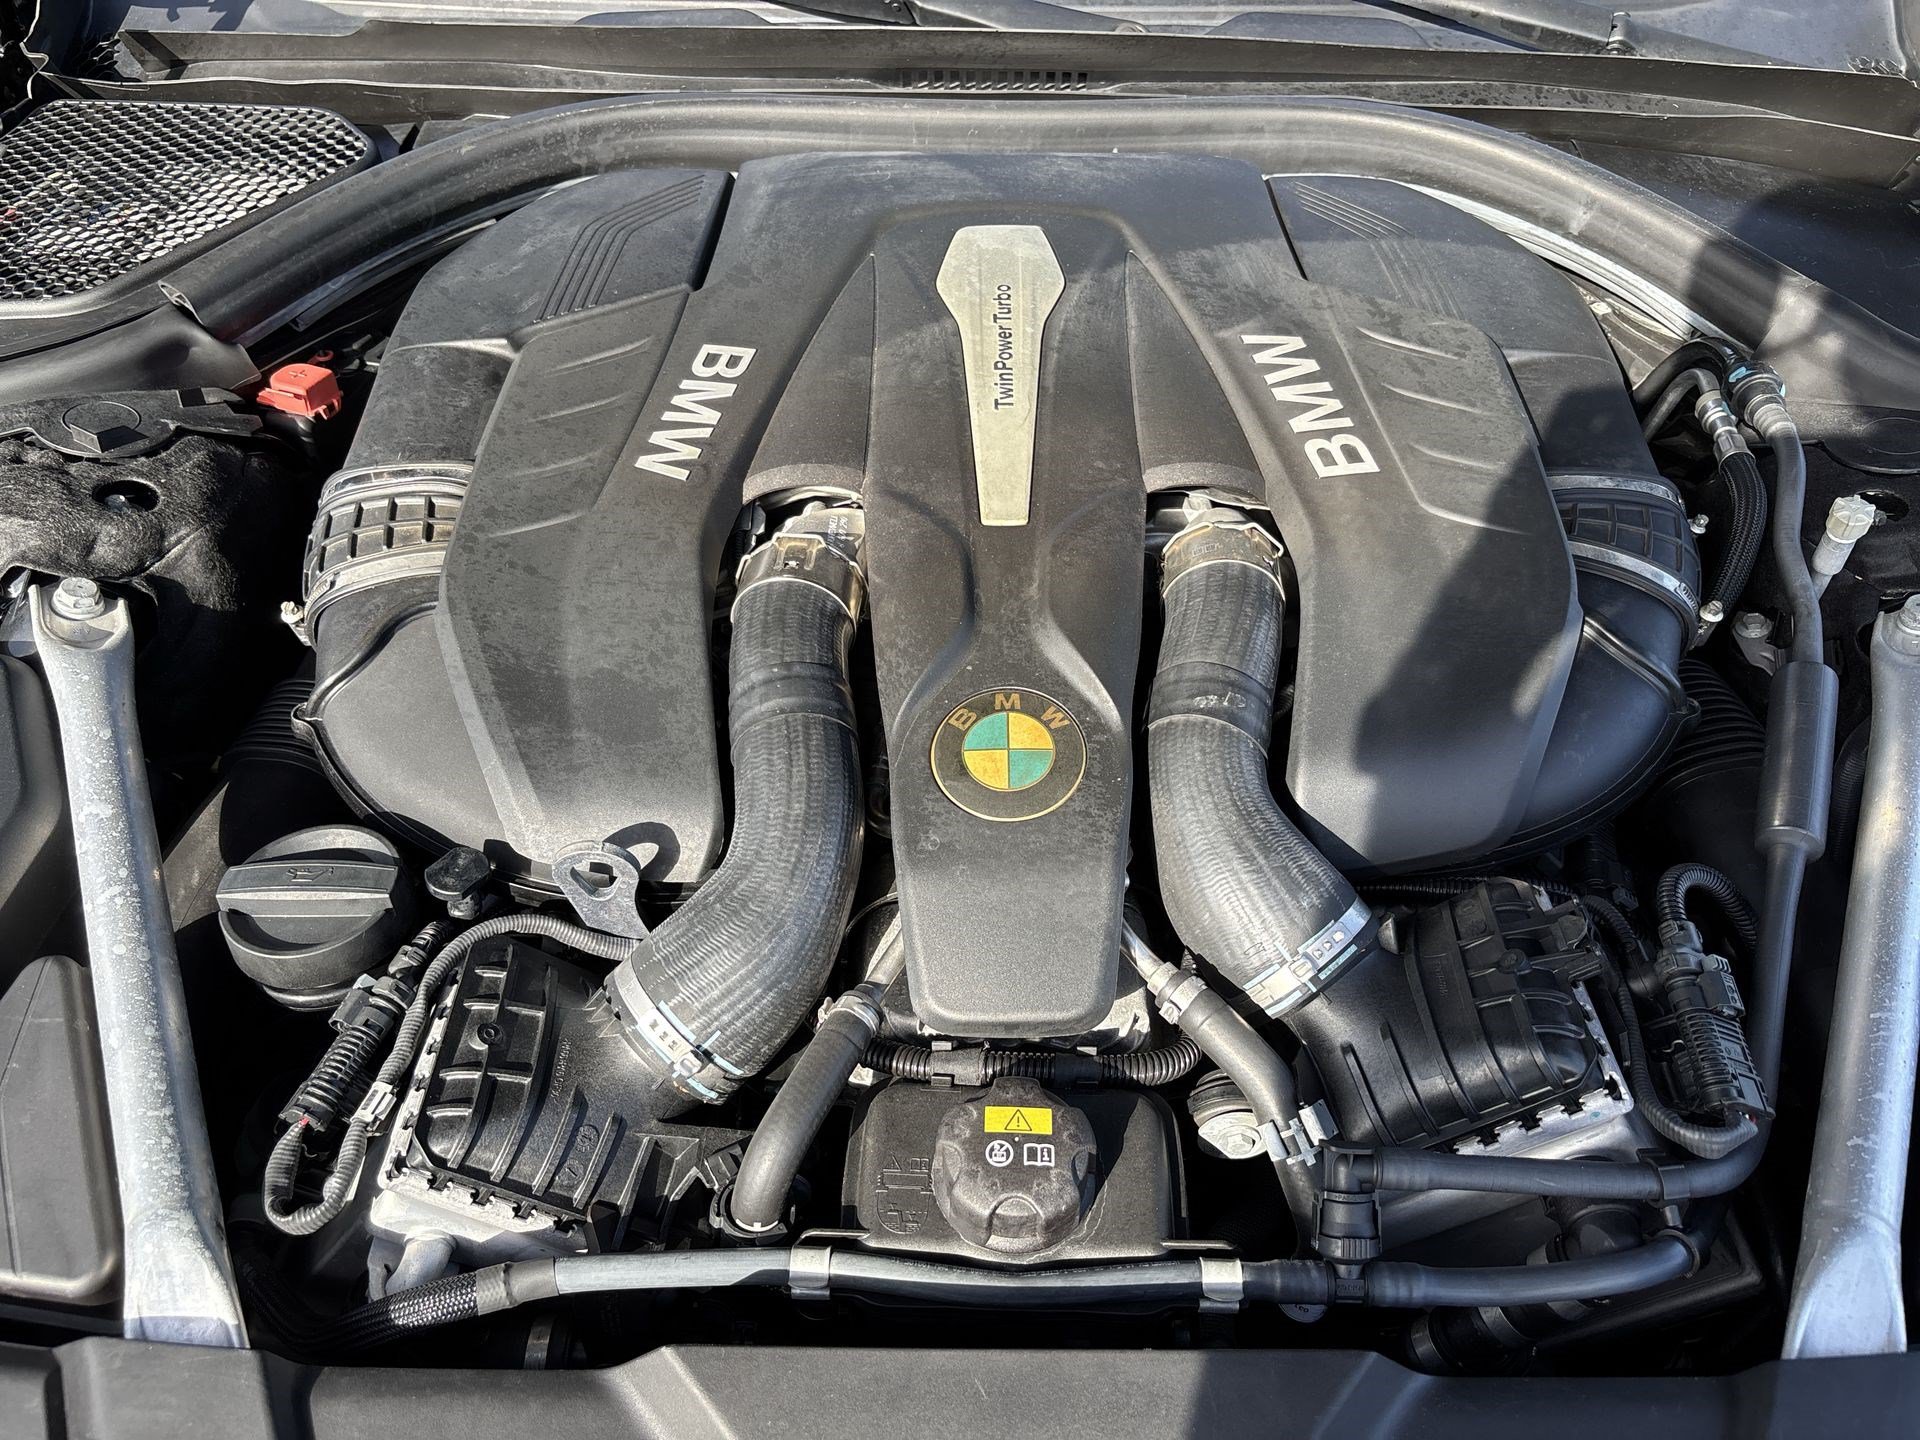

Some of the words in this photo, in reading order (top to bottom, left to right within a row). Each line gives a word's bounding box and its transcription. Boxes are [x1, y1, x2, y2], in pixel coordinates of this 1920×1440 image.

[635, 344, 756, 481] BMW
[1241, 334, 1380, 478] BMW
[951, 693, 1070, 731] BMW
